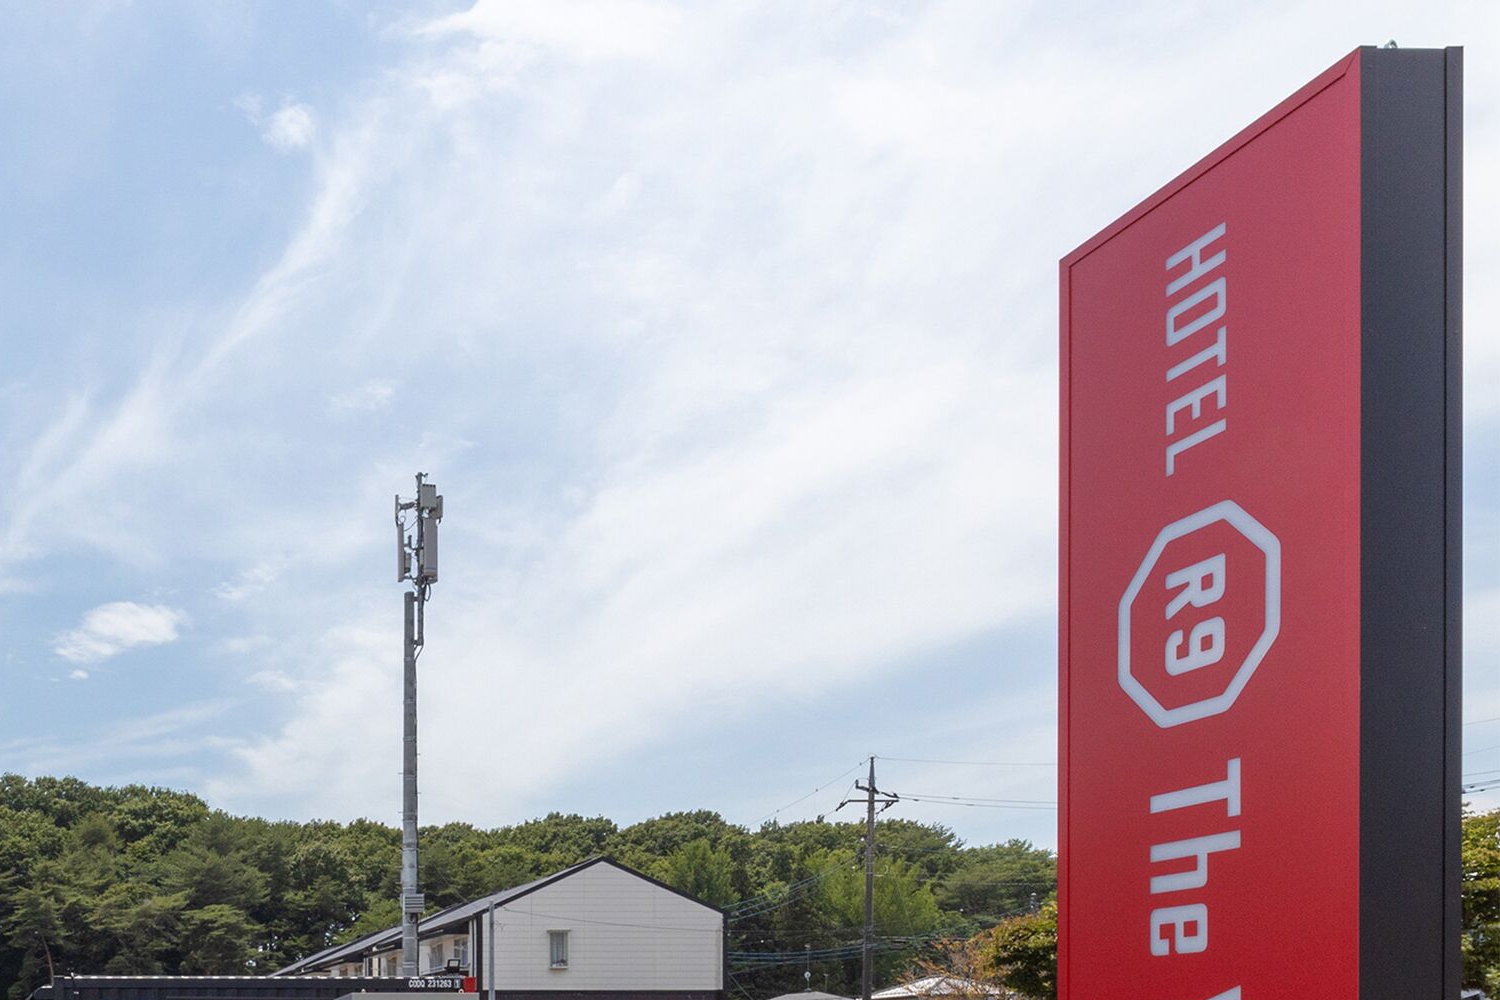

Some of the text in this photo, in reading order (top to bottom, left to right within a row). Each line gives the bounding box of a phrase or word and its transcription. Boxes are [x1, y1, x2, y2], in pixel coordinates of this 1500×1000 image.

[1165, 221, 1226, 478] HOTEL
[1165, 552, 1226, 679] R9
[1150, 757, 1241, 957] The
